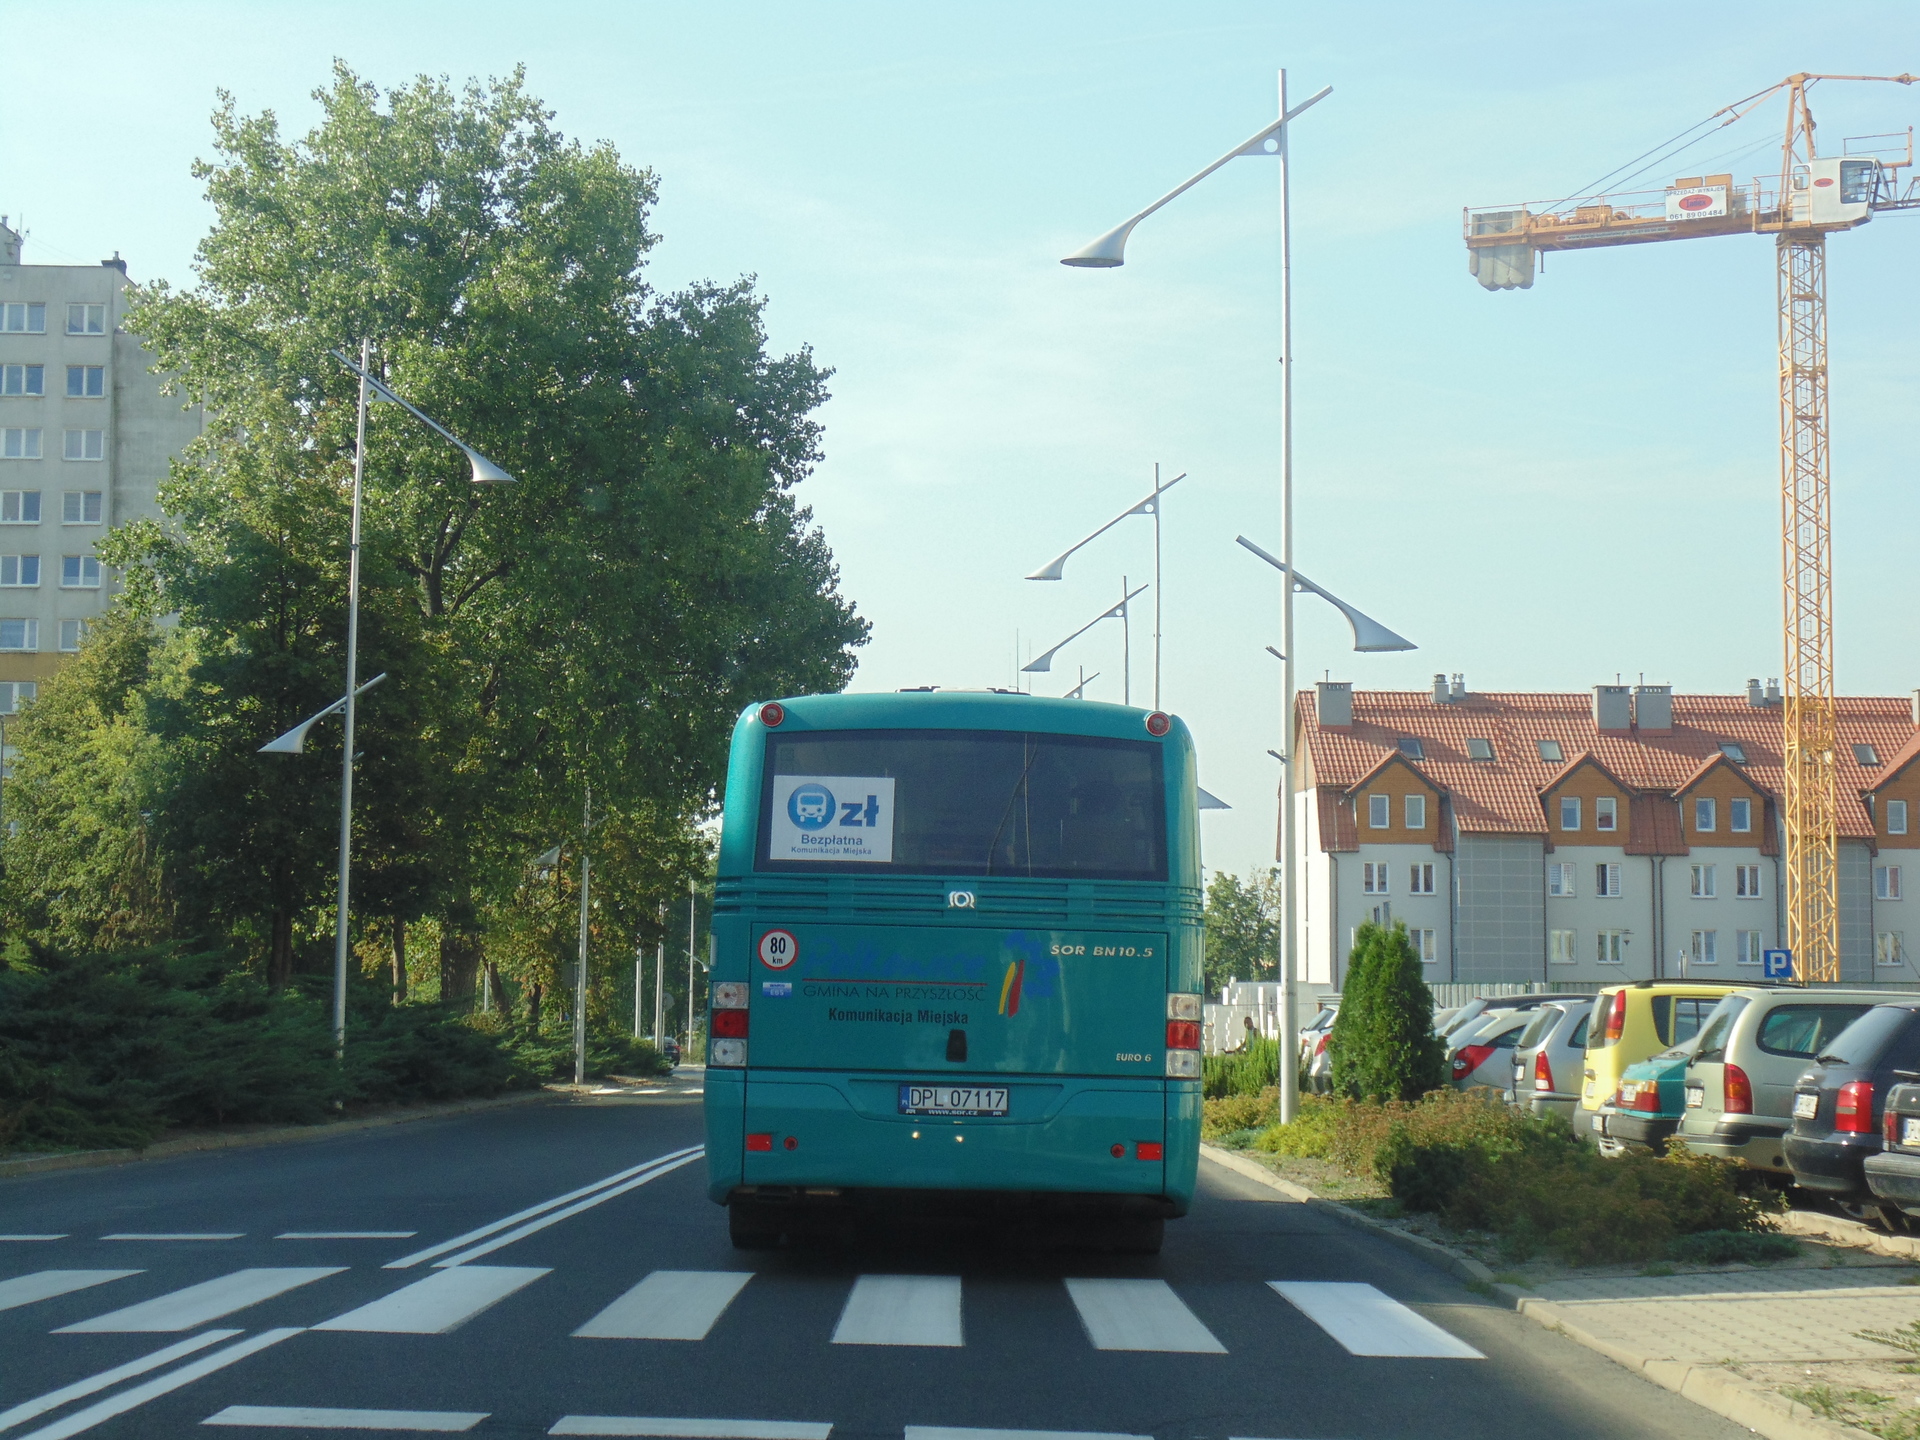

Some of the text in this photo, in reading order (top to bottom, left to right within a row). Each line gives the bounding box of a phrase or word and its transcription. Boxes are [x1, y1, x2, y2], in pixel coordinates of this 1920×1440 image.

[839, 795, 879, 827] zł
[801, 834, 863, 847] Bezpłatna
[791, 846, 872, 856] Komunikacja Miejska
[770, 937, 786, 954] 80
[1051, 945, 1086, 956] SOR
[772, 956, 783, 964] km
[1770, 952, 1787, 975] P
[803, 986, 986, 1002] GMINA NA PRZYSZŁOŚĆ
[829, 1008, 969, 1025] Komunikacja Miejska
[1115, 1053, 1152, 1062] EURO 6
[911, 1088, 1005, 1108] DPL 07117
